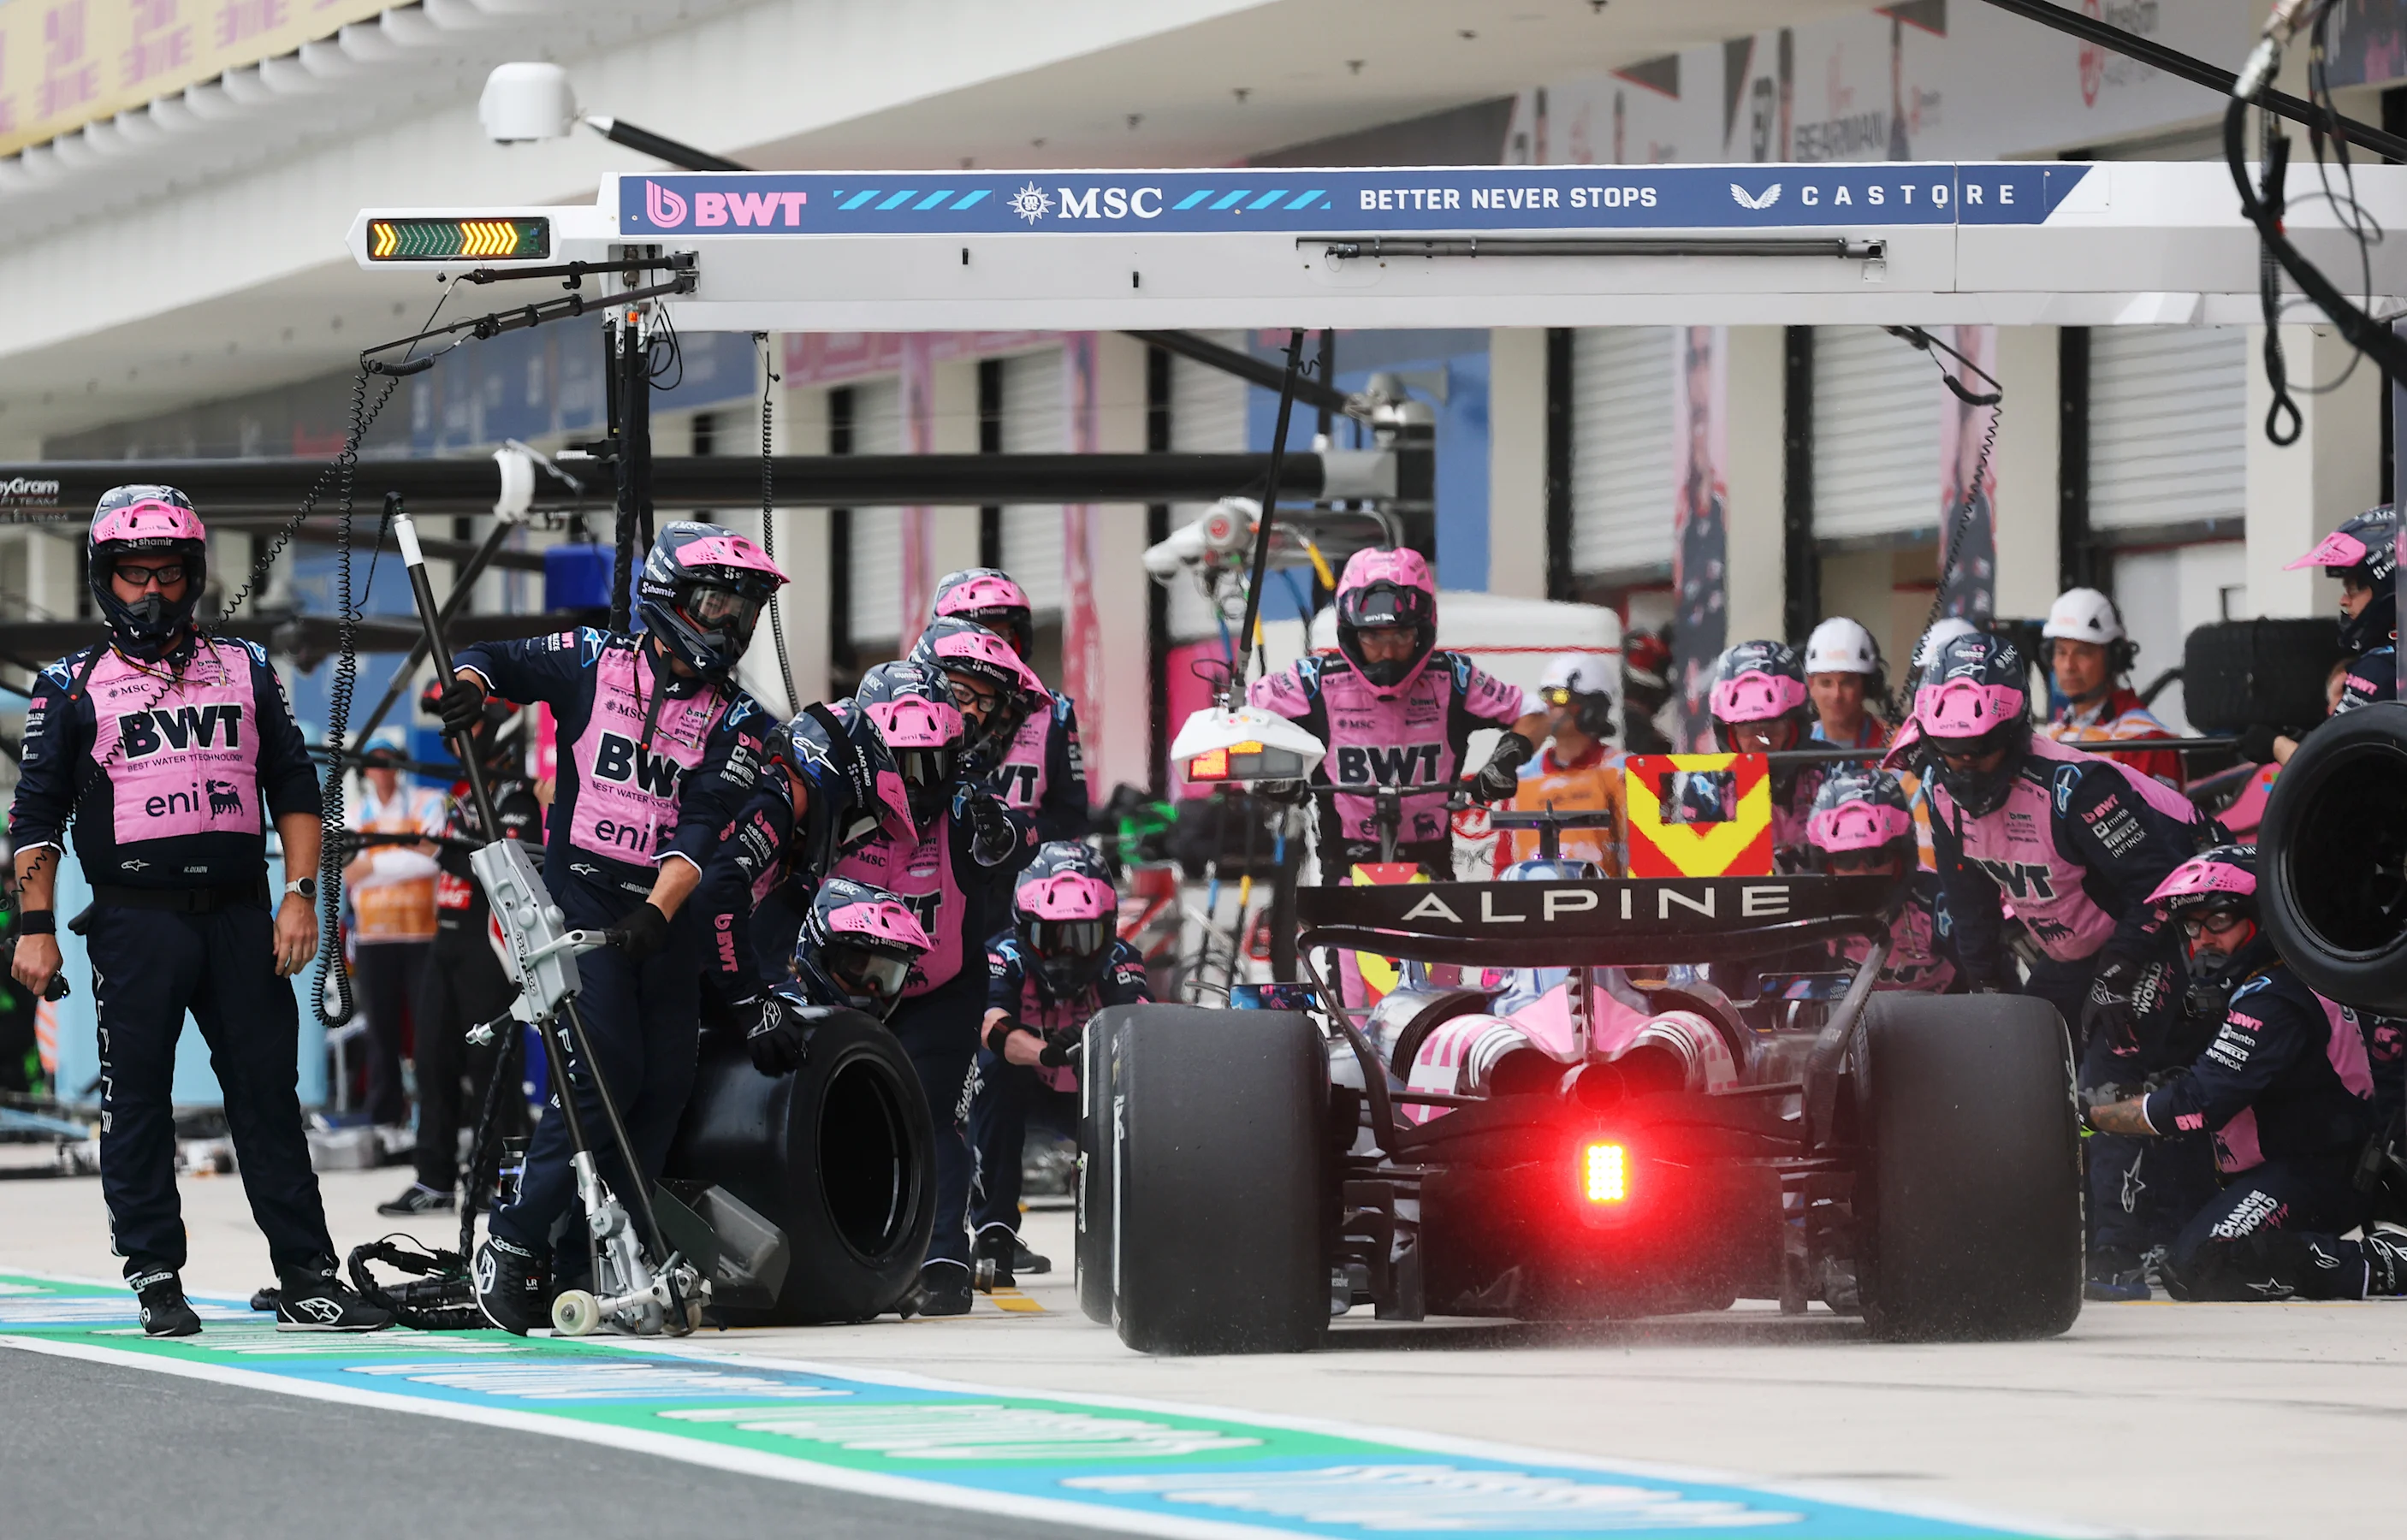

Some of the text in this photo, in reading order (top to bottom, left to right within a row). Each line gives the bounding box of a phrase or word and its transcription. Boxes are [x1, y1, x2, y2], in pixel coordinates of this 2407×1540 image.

[1057, 187, 1163, 219] MSC
[1360, 187, 1657, 210] BETTER NEVER STOPS
[1801, 184, 2015, 206] CASTORE
[695, 192, 807, 227] BWT
[2375, 510, 2396, 521] MS
[139, 538, 173, 547] shamir
[648, 586, 677, 599] shamir
[2000, 644, 2018, 665] MSC
[982, 664, 1008, 684] shamir
[121, 683, 151, 696] MSC
[618, 703, 647, 722] MSC
[116, 702, 244, 762] BWT
[1349, 720, 1376, 729] MSC
[127, 761, 150, 773] BEST
[151, 755, 187, 767] WATER
[1336, 742, 1443, 786] BWT
[145, 783, 199, 817] eni
[592, 780, 649, 803] BEST WATER
[595, 820, 650, 852] eni
[2112, 828, 2148, 859] INFINOX
[859, 852, 886, 868] MSC
[839, 883, 860, 895] MSC
[1402, 885, 1790, 923] ALPINE
[716, 931, 738, 973] BWT
[880, 938, 909, 951] shamir
[2137, 962, 2162, 1014] WORLD
[2232, 1012, 2264, 1032] BWT
[93, 964, 113, 1134] ALPINE
[2230, 1030, 2256, 1048] mntn
[2175, 1112, 2204, 1131] BW
[2218, 1189, 2268, 1238] CHANGE
[2239, 1197, 2278, 1236] WORLD
[526, 1278, 537, 1287] LR
